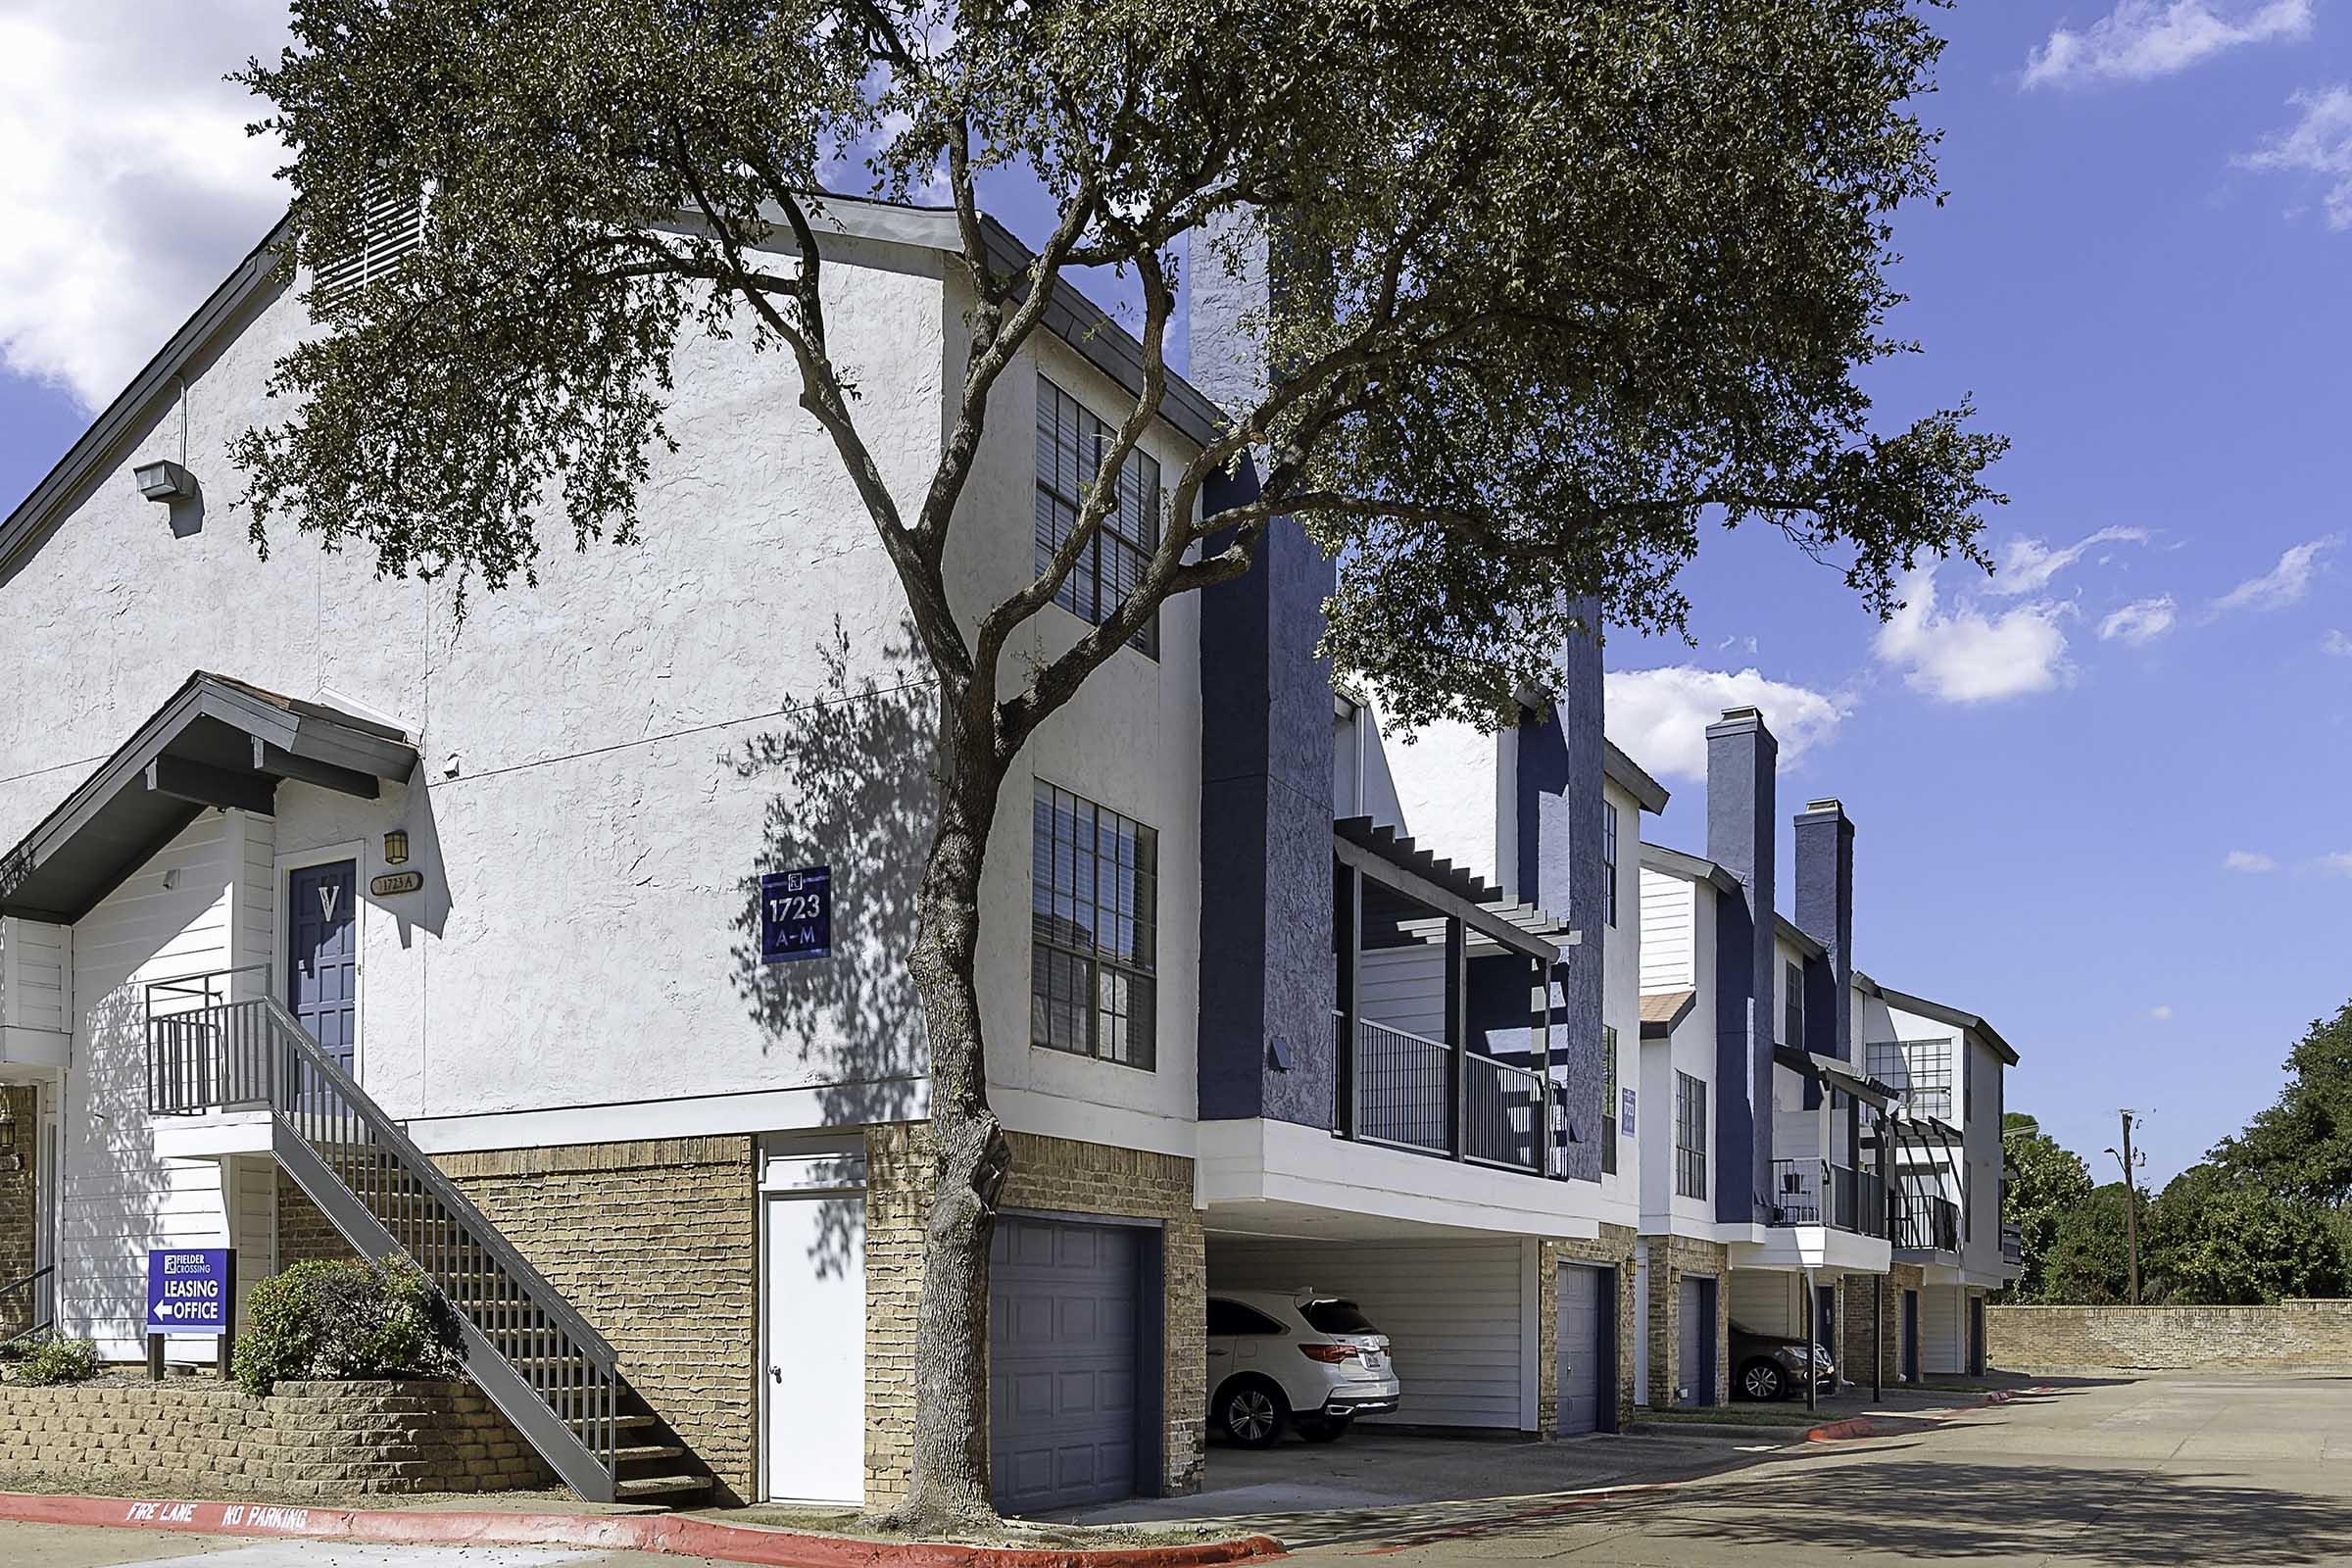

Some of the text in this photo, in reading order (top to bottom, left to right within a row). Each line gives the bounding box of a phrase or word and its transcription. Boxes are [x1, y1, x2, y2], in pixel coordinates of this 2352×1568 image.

[318, 886, 340, 922] V
[769, 894, 820, 922] 1723
[775, 925, 815, 947] A-M
[176, 1254, 205, 1264] FIELDER
[176, 1264, 211, 1274] CROSSING
[165, 1280, 219, 1298] LEASING
[173, 1301, 219, 1319] OFFICE
[125, 1502, 309, 1529] FIRE LANE NO PARKING
